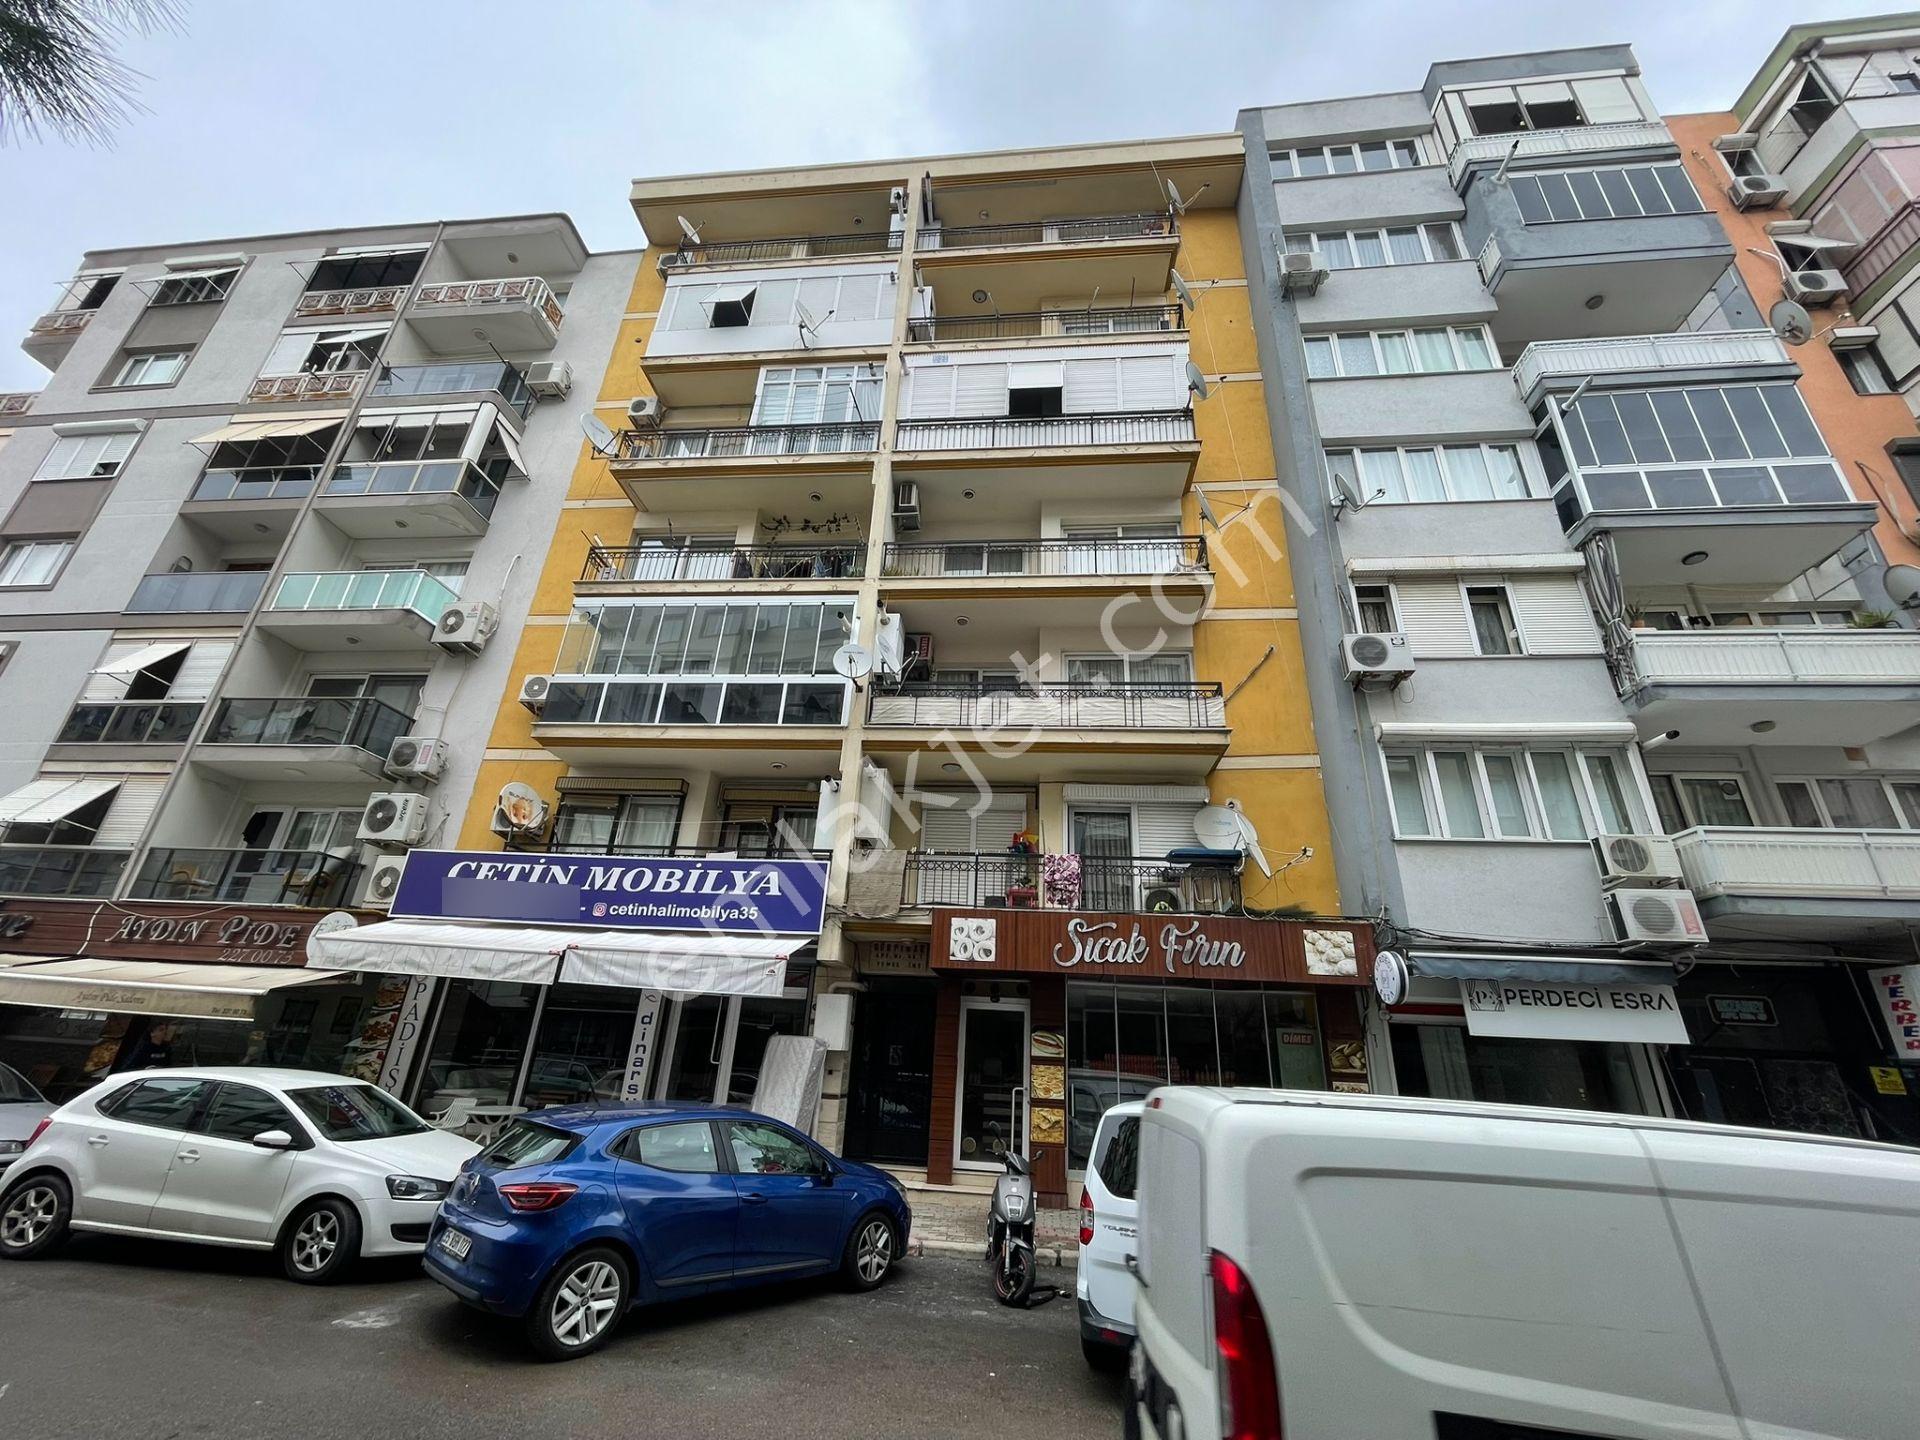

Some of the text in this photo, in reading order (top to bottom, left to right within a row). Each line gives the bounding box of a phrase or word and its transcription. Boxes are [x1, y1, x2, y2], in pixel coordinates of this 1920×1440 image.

[580, 863, 782, 896] MOBİLYA
[609, 902, 758, 922] cetinhalimobilya35
[105, 915, 210, 942] AYDIN
[217, 948, 295, 964] 227 00 73
[1503, 987, 1603, 1009] PERDECİ
[626, 1011, 654, 1101] dinars
